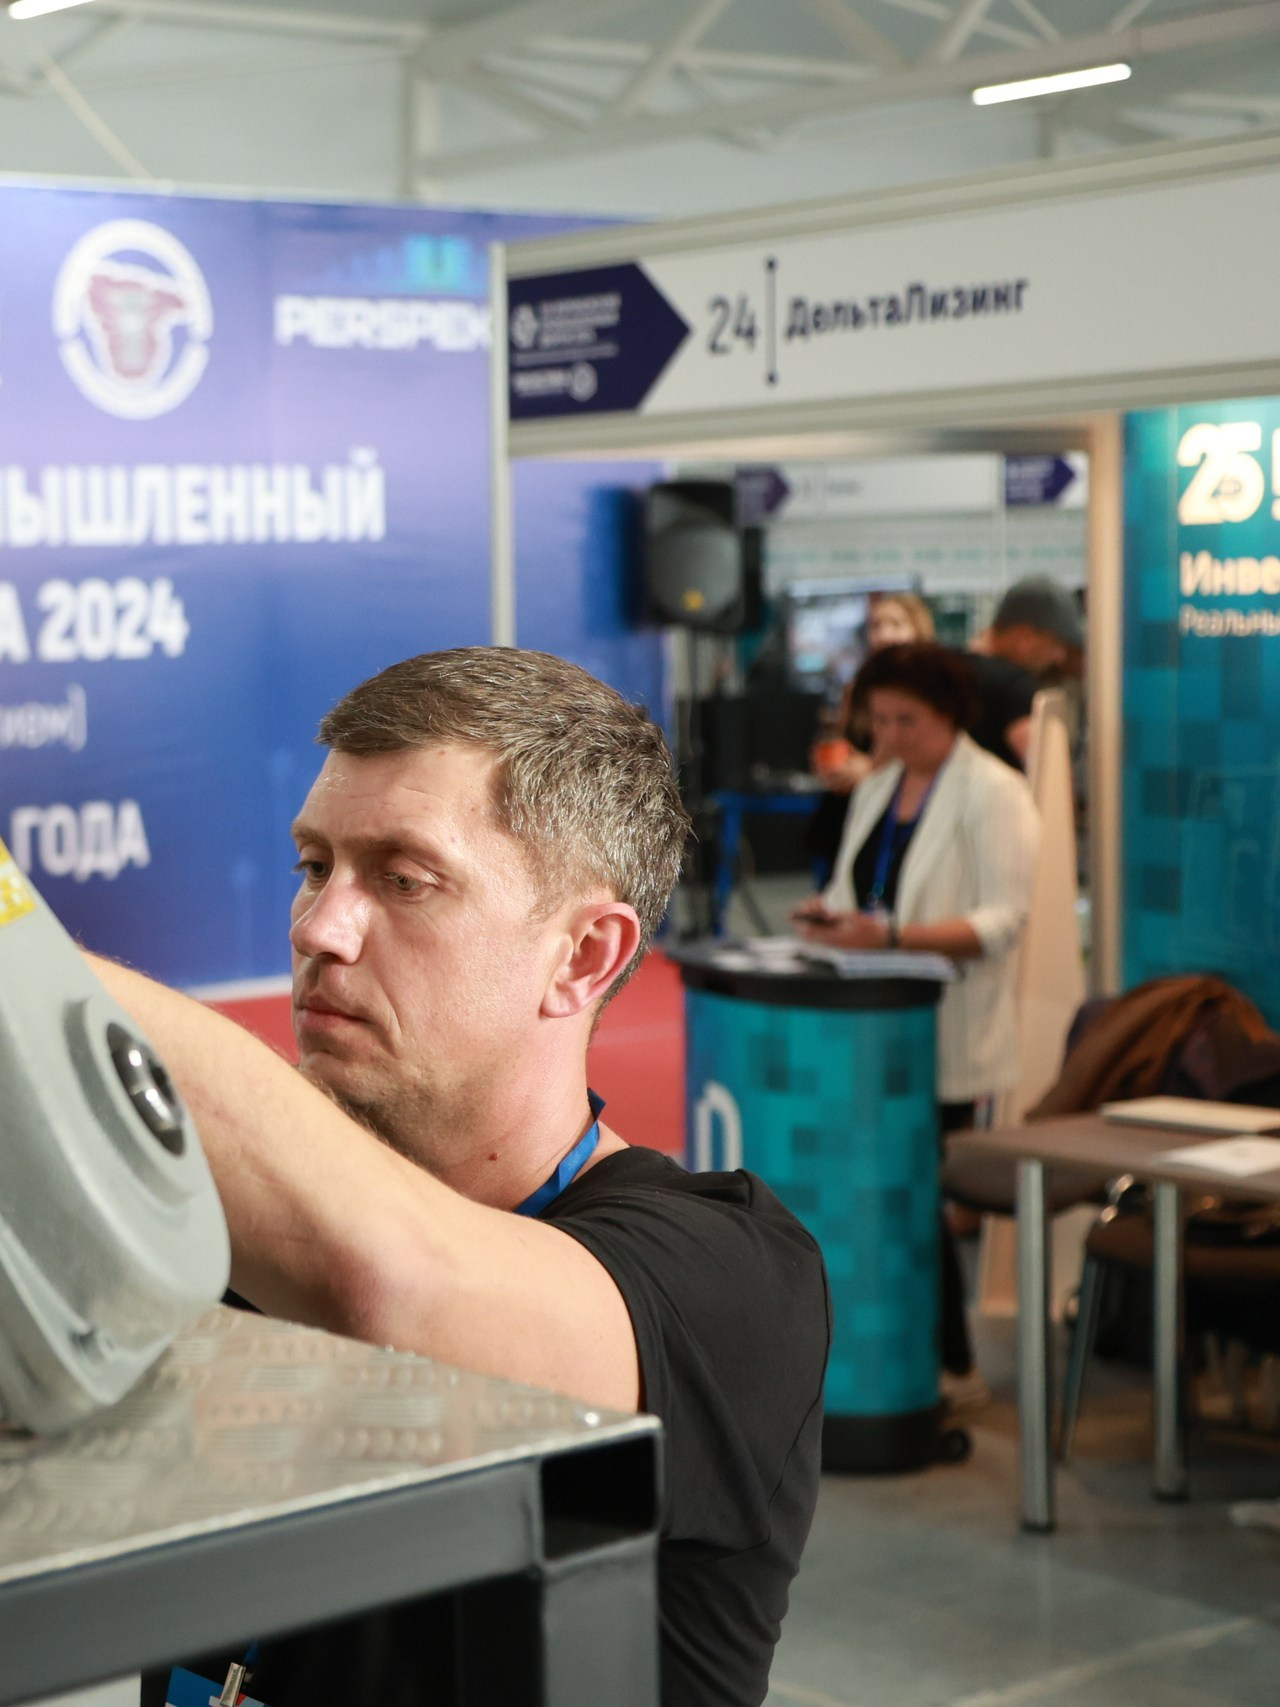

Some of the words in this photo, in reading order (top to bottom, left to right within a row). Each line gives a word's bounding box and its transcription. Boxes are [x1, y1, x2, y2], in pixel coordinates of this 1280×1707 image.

[706, 294, 758, 354] 24
[783, 277, 1030, 345] ДельтаЛизинг
[1177, 420, 1265, 525] 25
[35, 576, 189, 662] 2024
[10, 798, 151, 882] ГОДА
